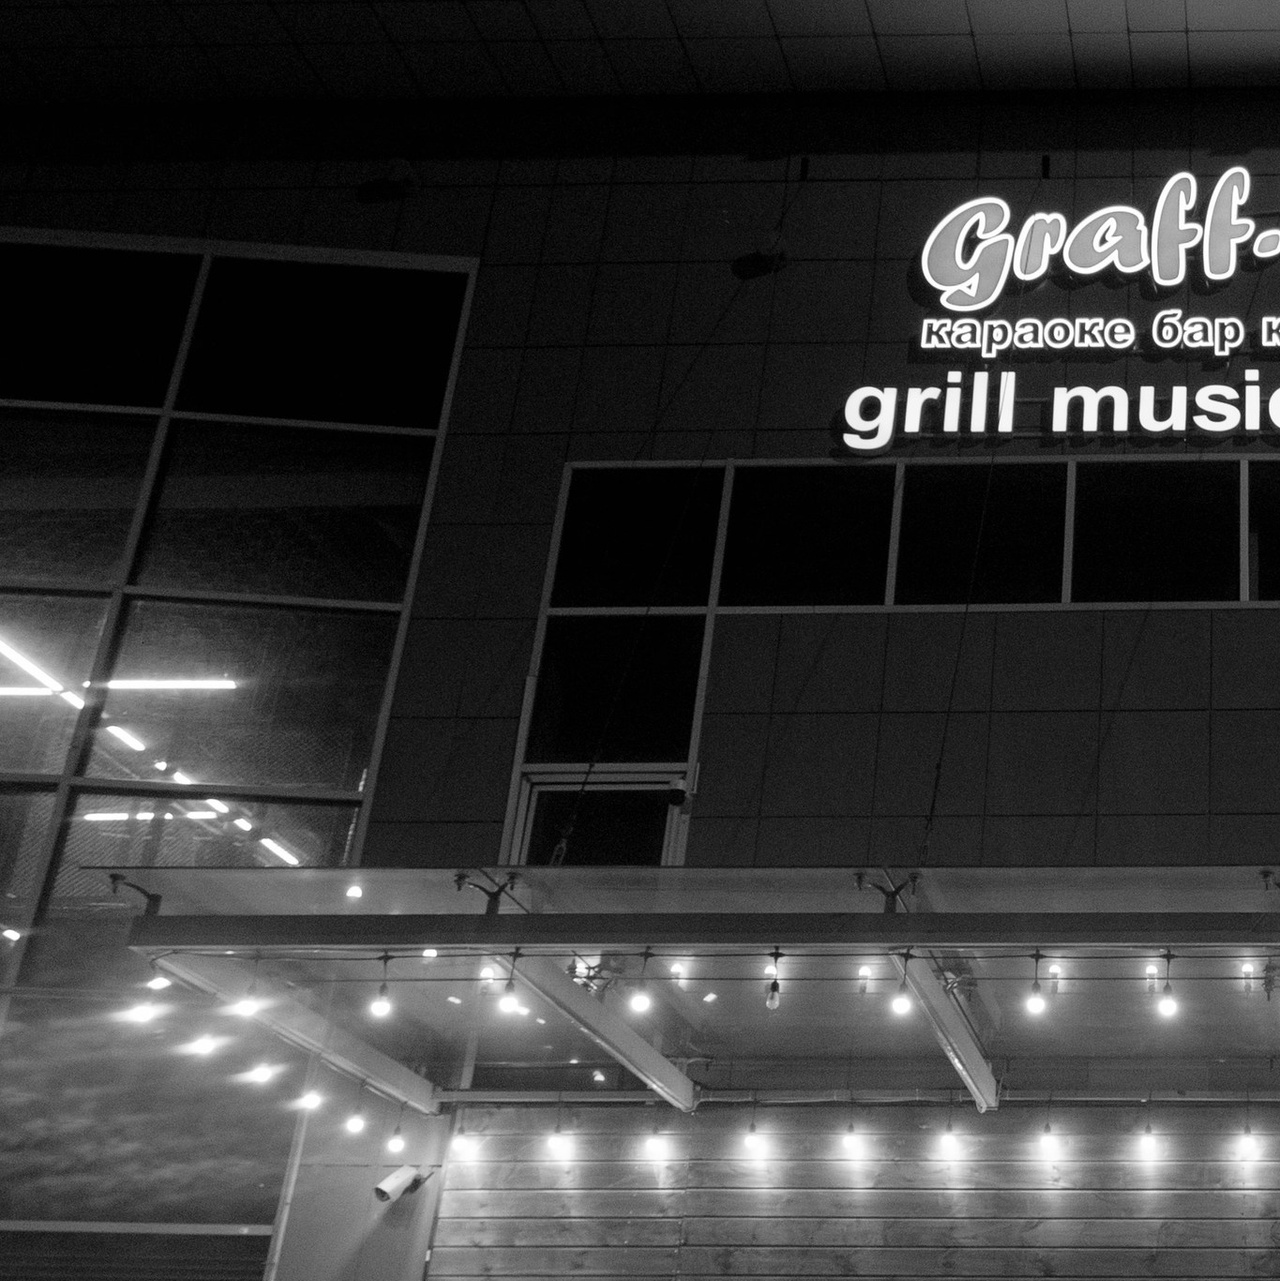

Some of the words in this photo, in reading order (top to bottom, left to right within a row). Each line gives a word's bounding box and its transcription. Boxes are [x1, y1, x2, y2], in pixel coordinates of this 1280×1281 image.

[920, 317, 1135, 357] караоке
[1151, 308, 1244, 355] бар
[843, 371, 1016, 450] grill
